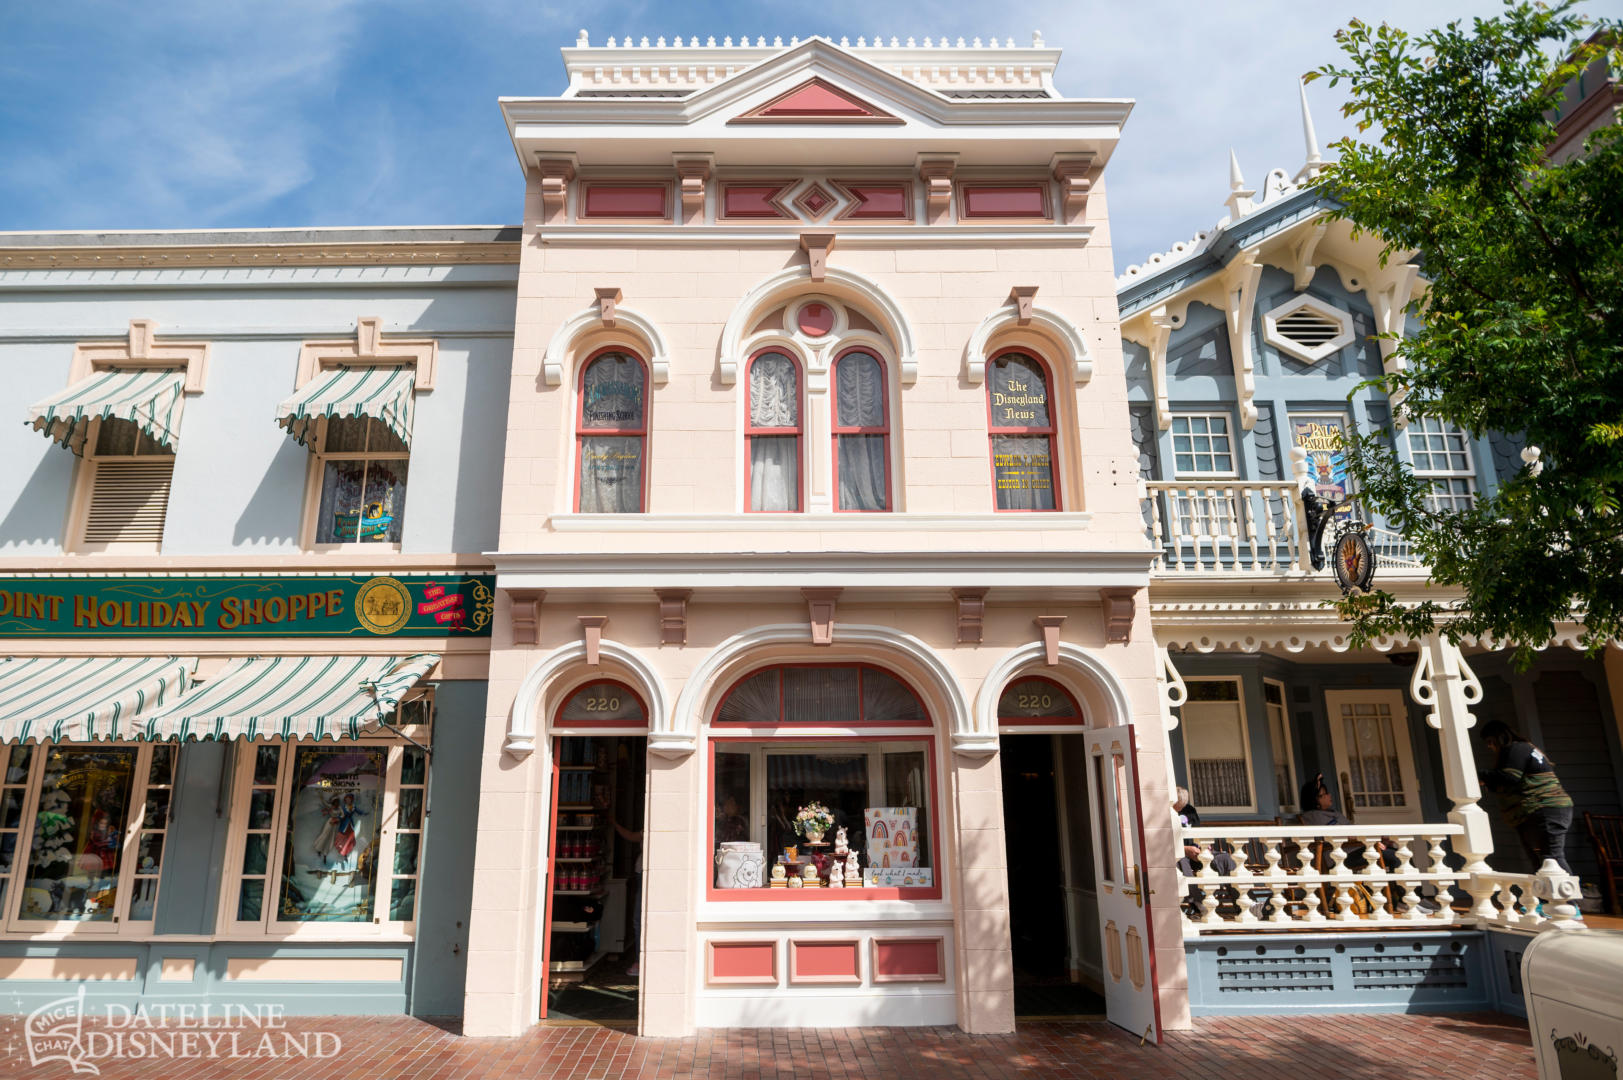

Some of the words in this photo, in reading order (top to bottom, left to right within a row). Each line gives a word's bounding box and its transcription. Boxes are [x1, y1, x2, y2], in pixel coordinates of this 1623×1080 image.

[1007, 380, 1027, 392] The
[992, 392, 1045, 407] Disneyland
[1003, 407, 1035, 419] News
[1308, 422, 1340, 438] PALM
[73, 594, 210, 628] HOLIDAY
[217, 589, 344, 630] SHOPPE
[586, 698, 620, 711] 220
[1018, 695, 1051, 708] 220
